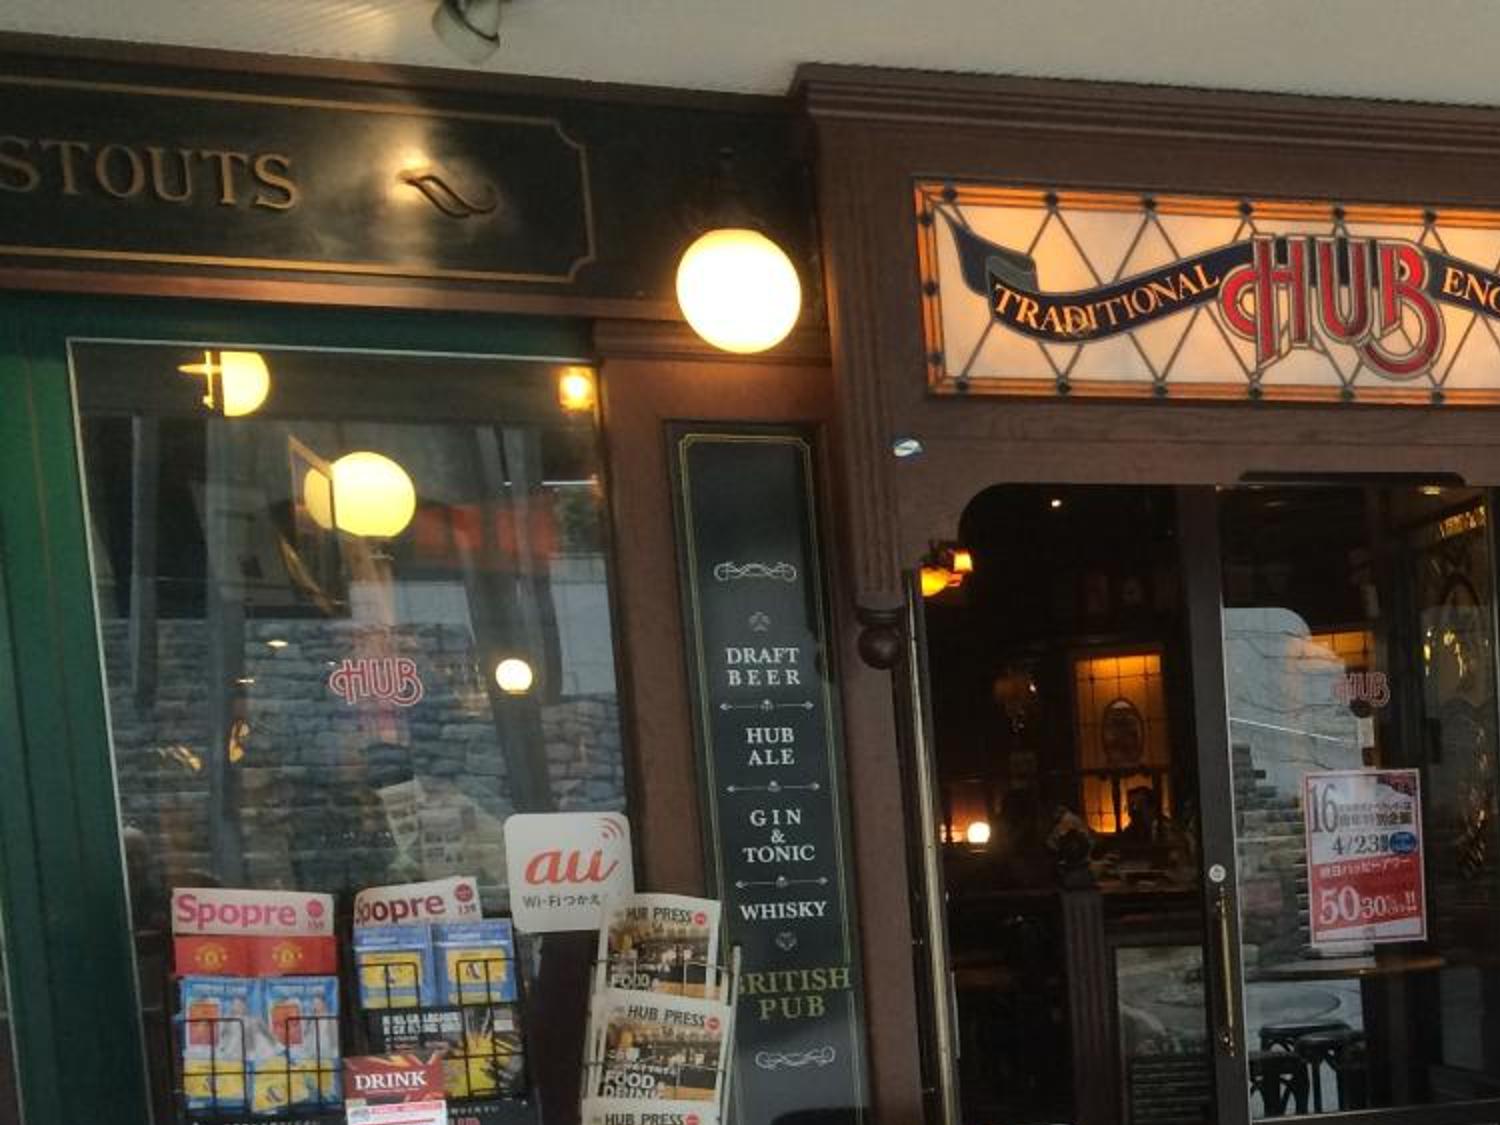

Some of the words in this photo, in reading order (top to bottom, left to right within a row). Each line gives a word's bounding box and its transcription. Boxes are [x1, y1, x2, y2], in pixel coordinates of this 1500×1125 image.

[0, 136, 299, 211] STOUTS
[992, 263, 1221, 338] TRADITIONAL
[1220, 233, 1446, 379] HUB
[725, 647, 800, 666] DRAFT
[329, 658, 423, 707] HUB
[728, 669, 801, 687] BEER
[746, 727, 796, 745] HUB
[748, 748, 796, 766] ALE
[750, 809, 802, 827] GIN
[770, 829, 787, 844] &
[742, 844, 816, 864] TONIC
[524, 848, 619, 885] au
[176, 893, 297, 929] Spopre
[739, 901, 828, 921] WHISKY
[628, 1004, 658, 1021] HUB
[665, 1009, 705, 1026] PRESS
[758, 995, 826, 1020] PUB
[354, 1071, 427, 1091] DRINK
[605, 1069, 655, 1089] FOOD
